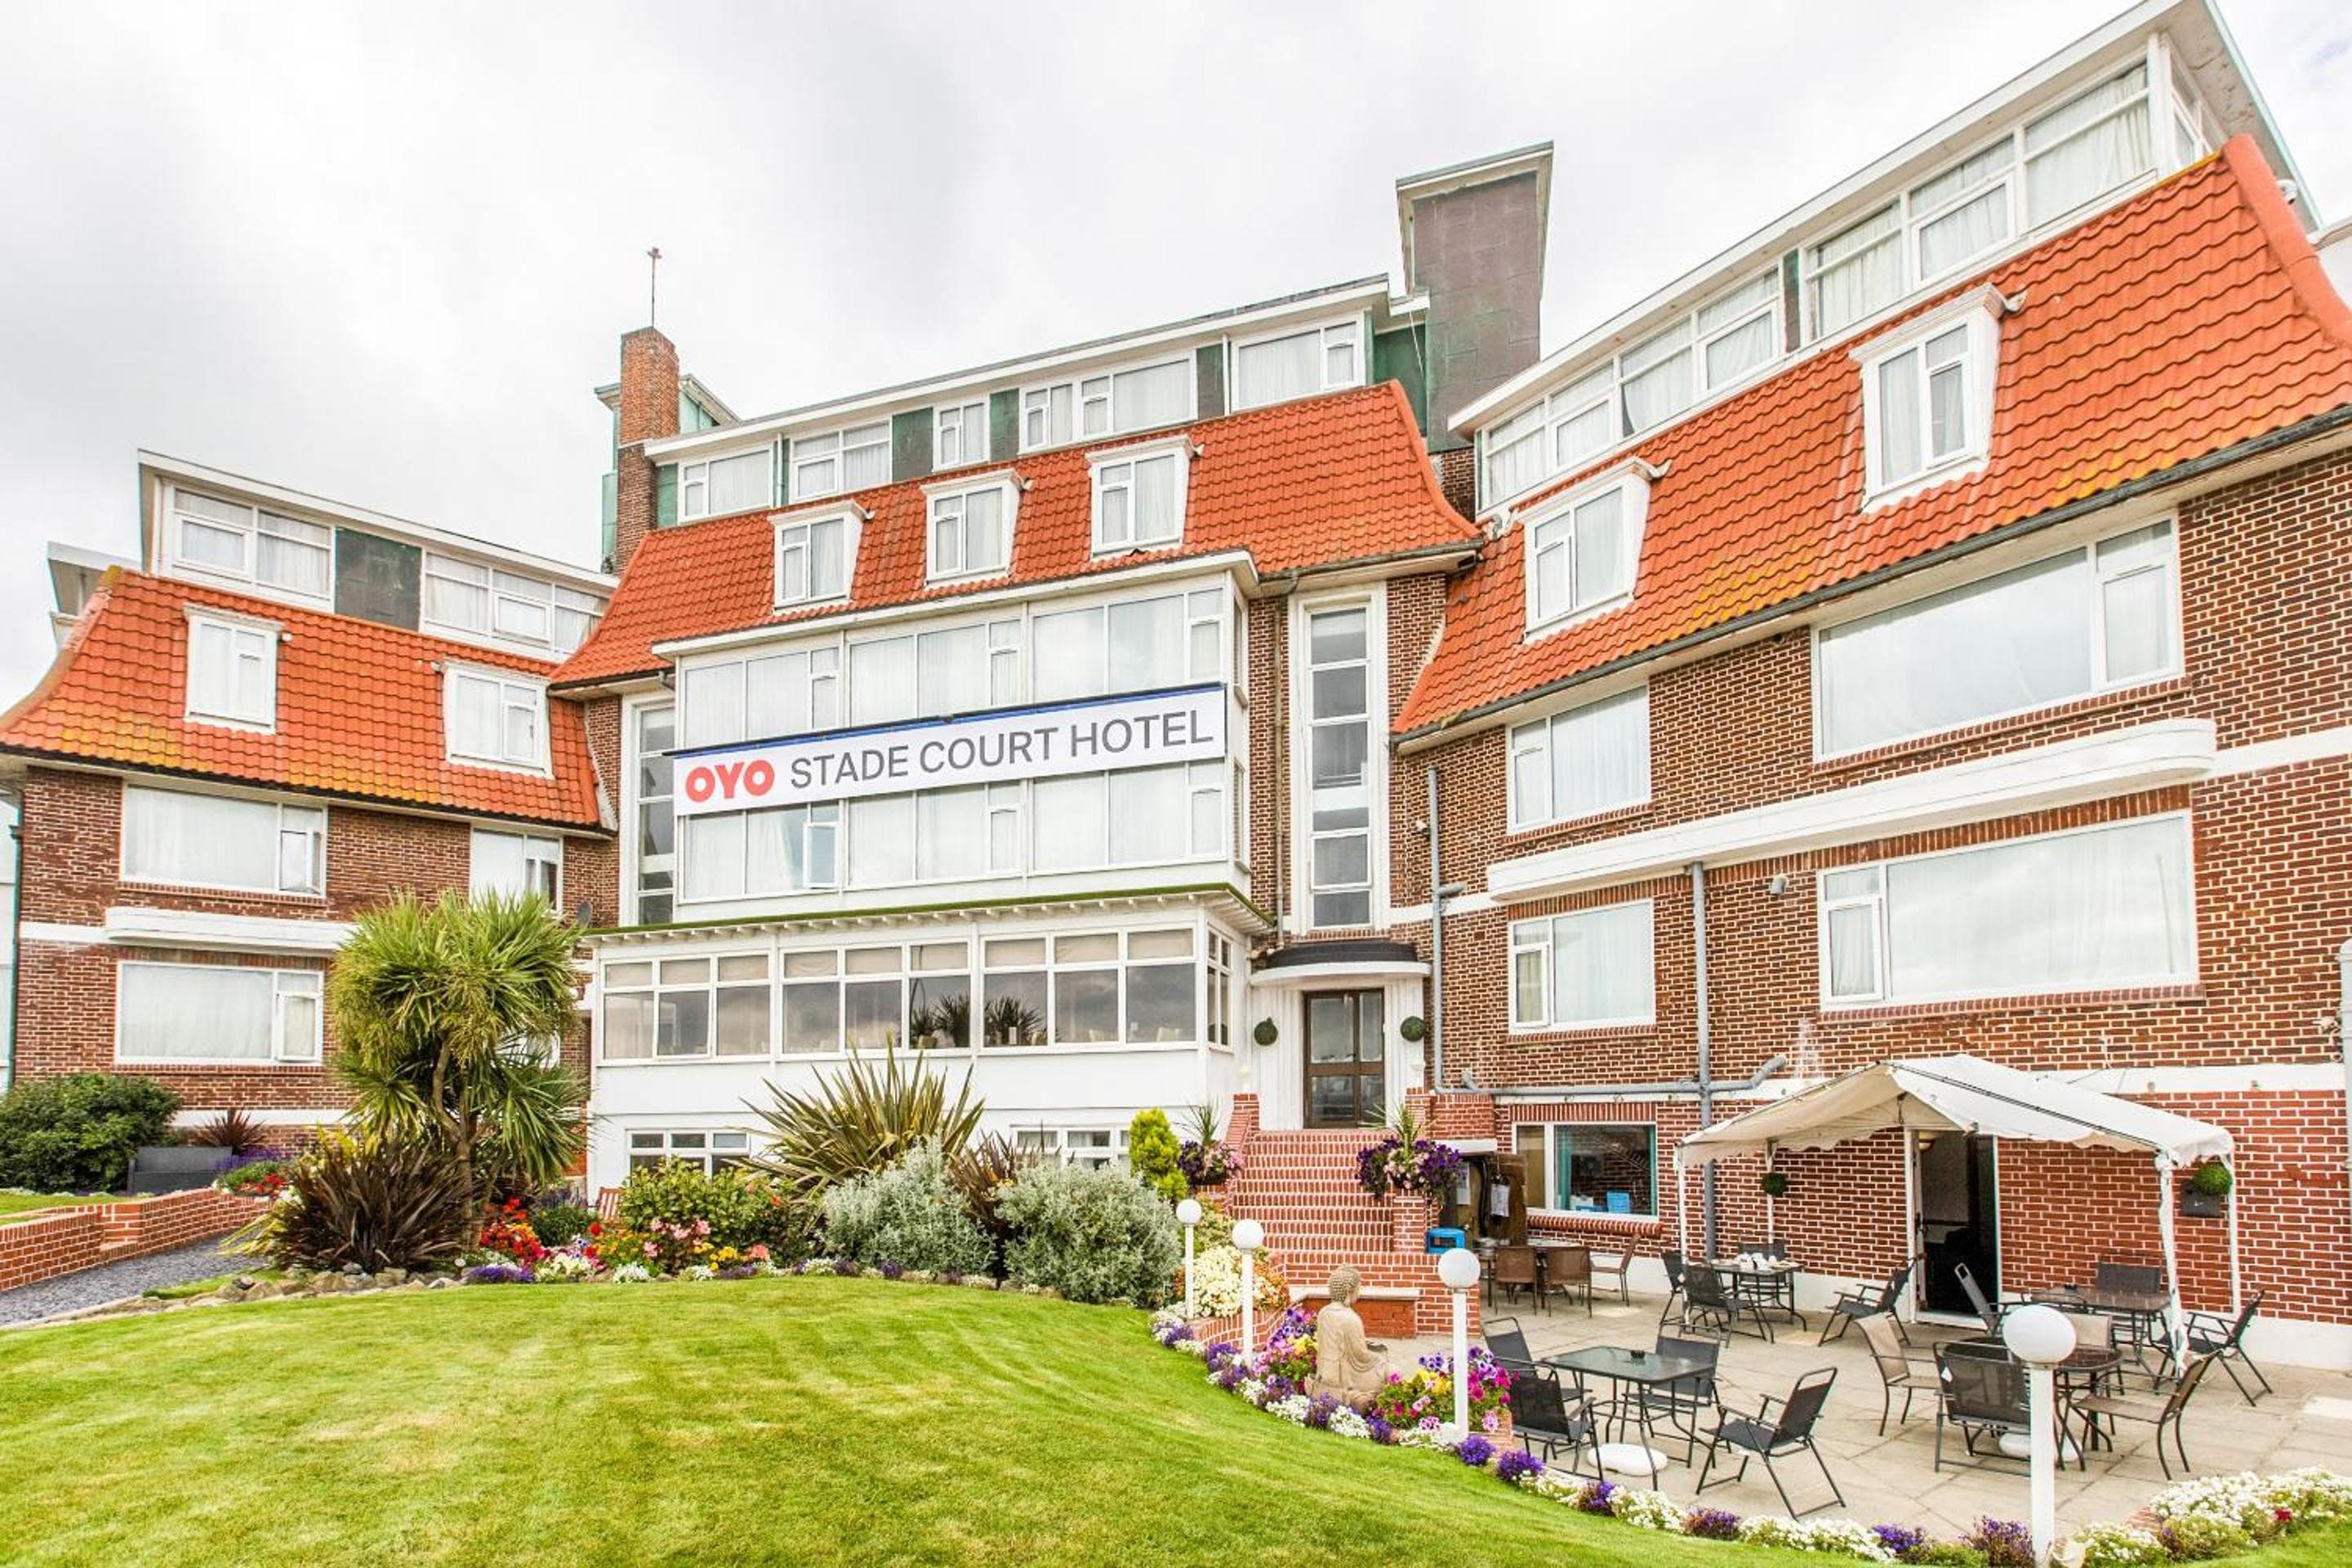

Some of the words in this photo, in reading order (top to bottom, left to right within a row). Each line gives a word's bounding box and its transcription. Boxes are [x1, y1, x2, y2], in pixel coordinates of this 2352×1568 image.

[685, 760, 775, 803] OYO
[791, 745, 909, 789] STADE
[920, 728, 1059, 773] COURT
[1071, 710, 1214, 758] HOTEL
